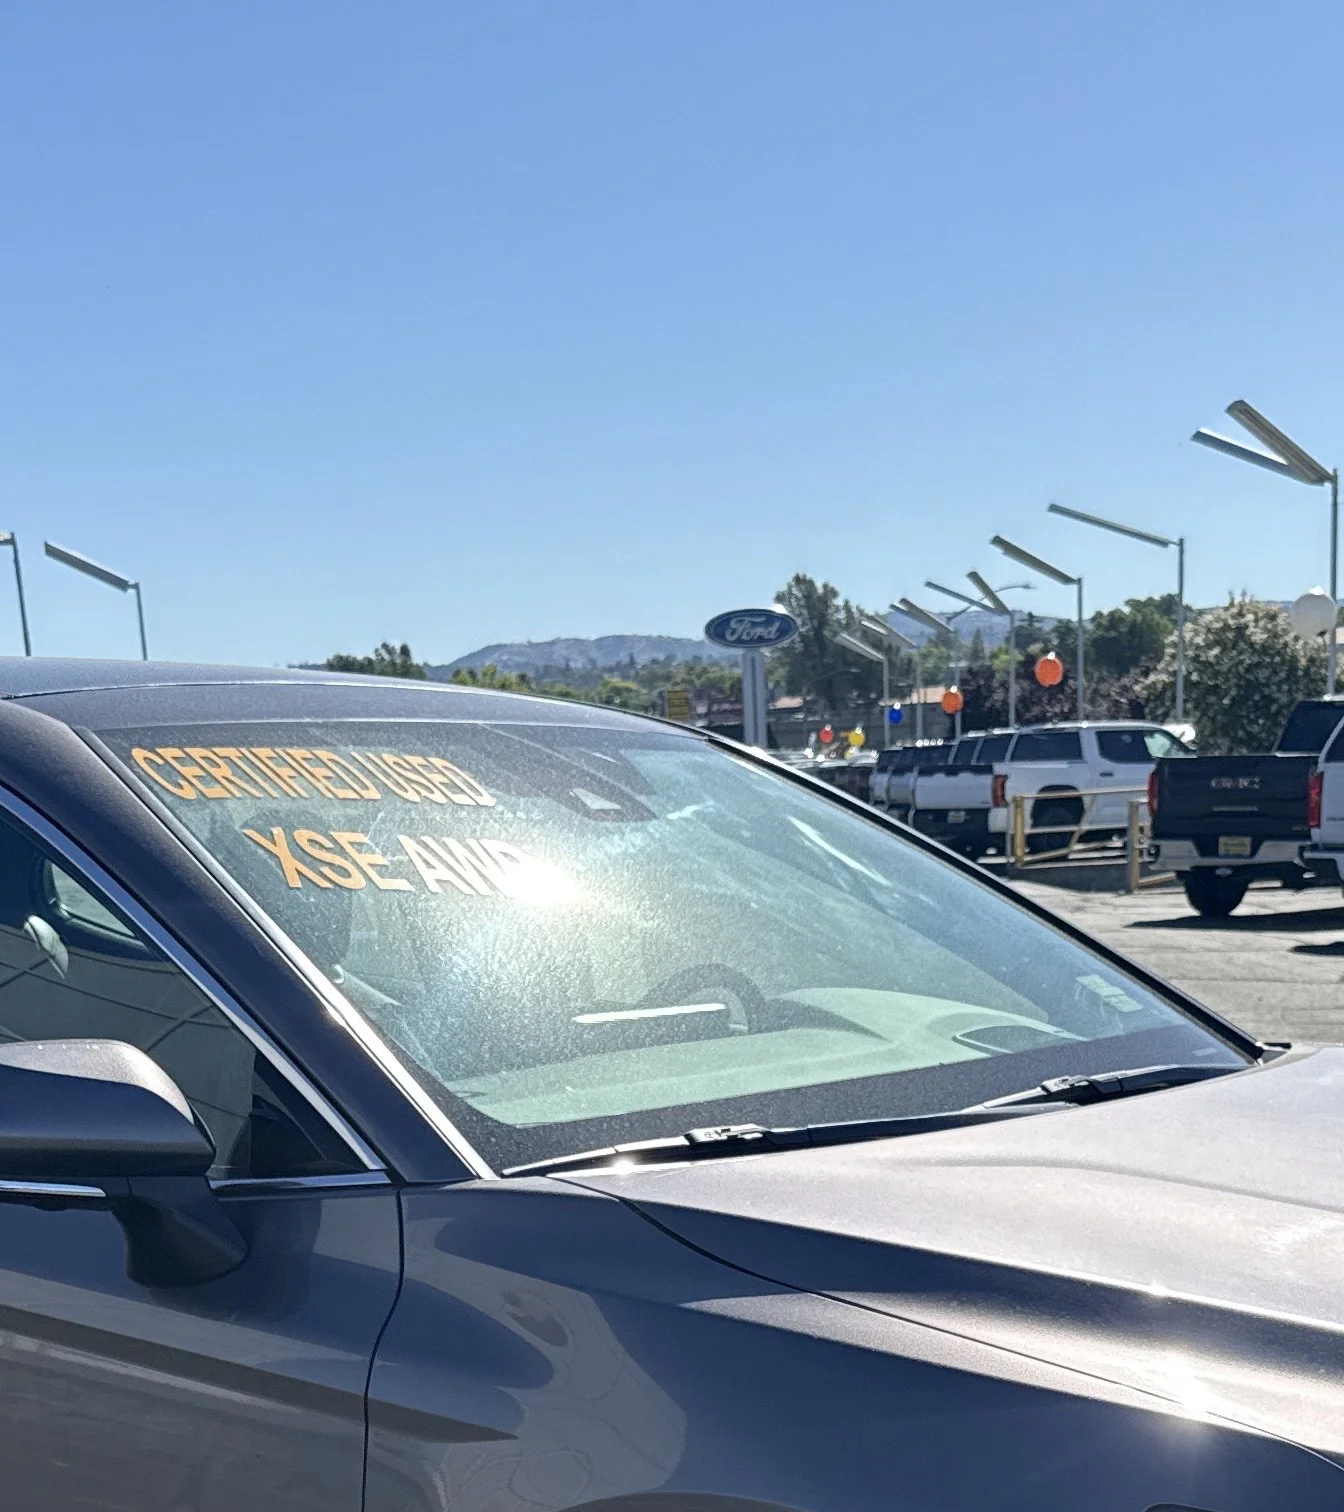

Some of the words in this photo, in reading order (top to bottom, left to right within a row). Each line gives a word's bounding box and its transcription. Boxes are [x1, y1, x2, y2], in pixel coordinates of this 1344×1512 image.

[725, 615, 781, 642] Ford
[130, 746, 383, 801] CERTIFIED
[350, 750, 497, 807] USED
[242, 825, 417, 891] XSE
